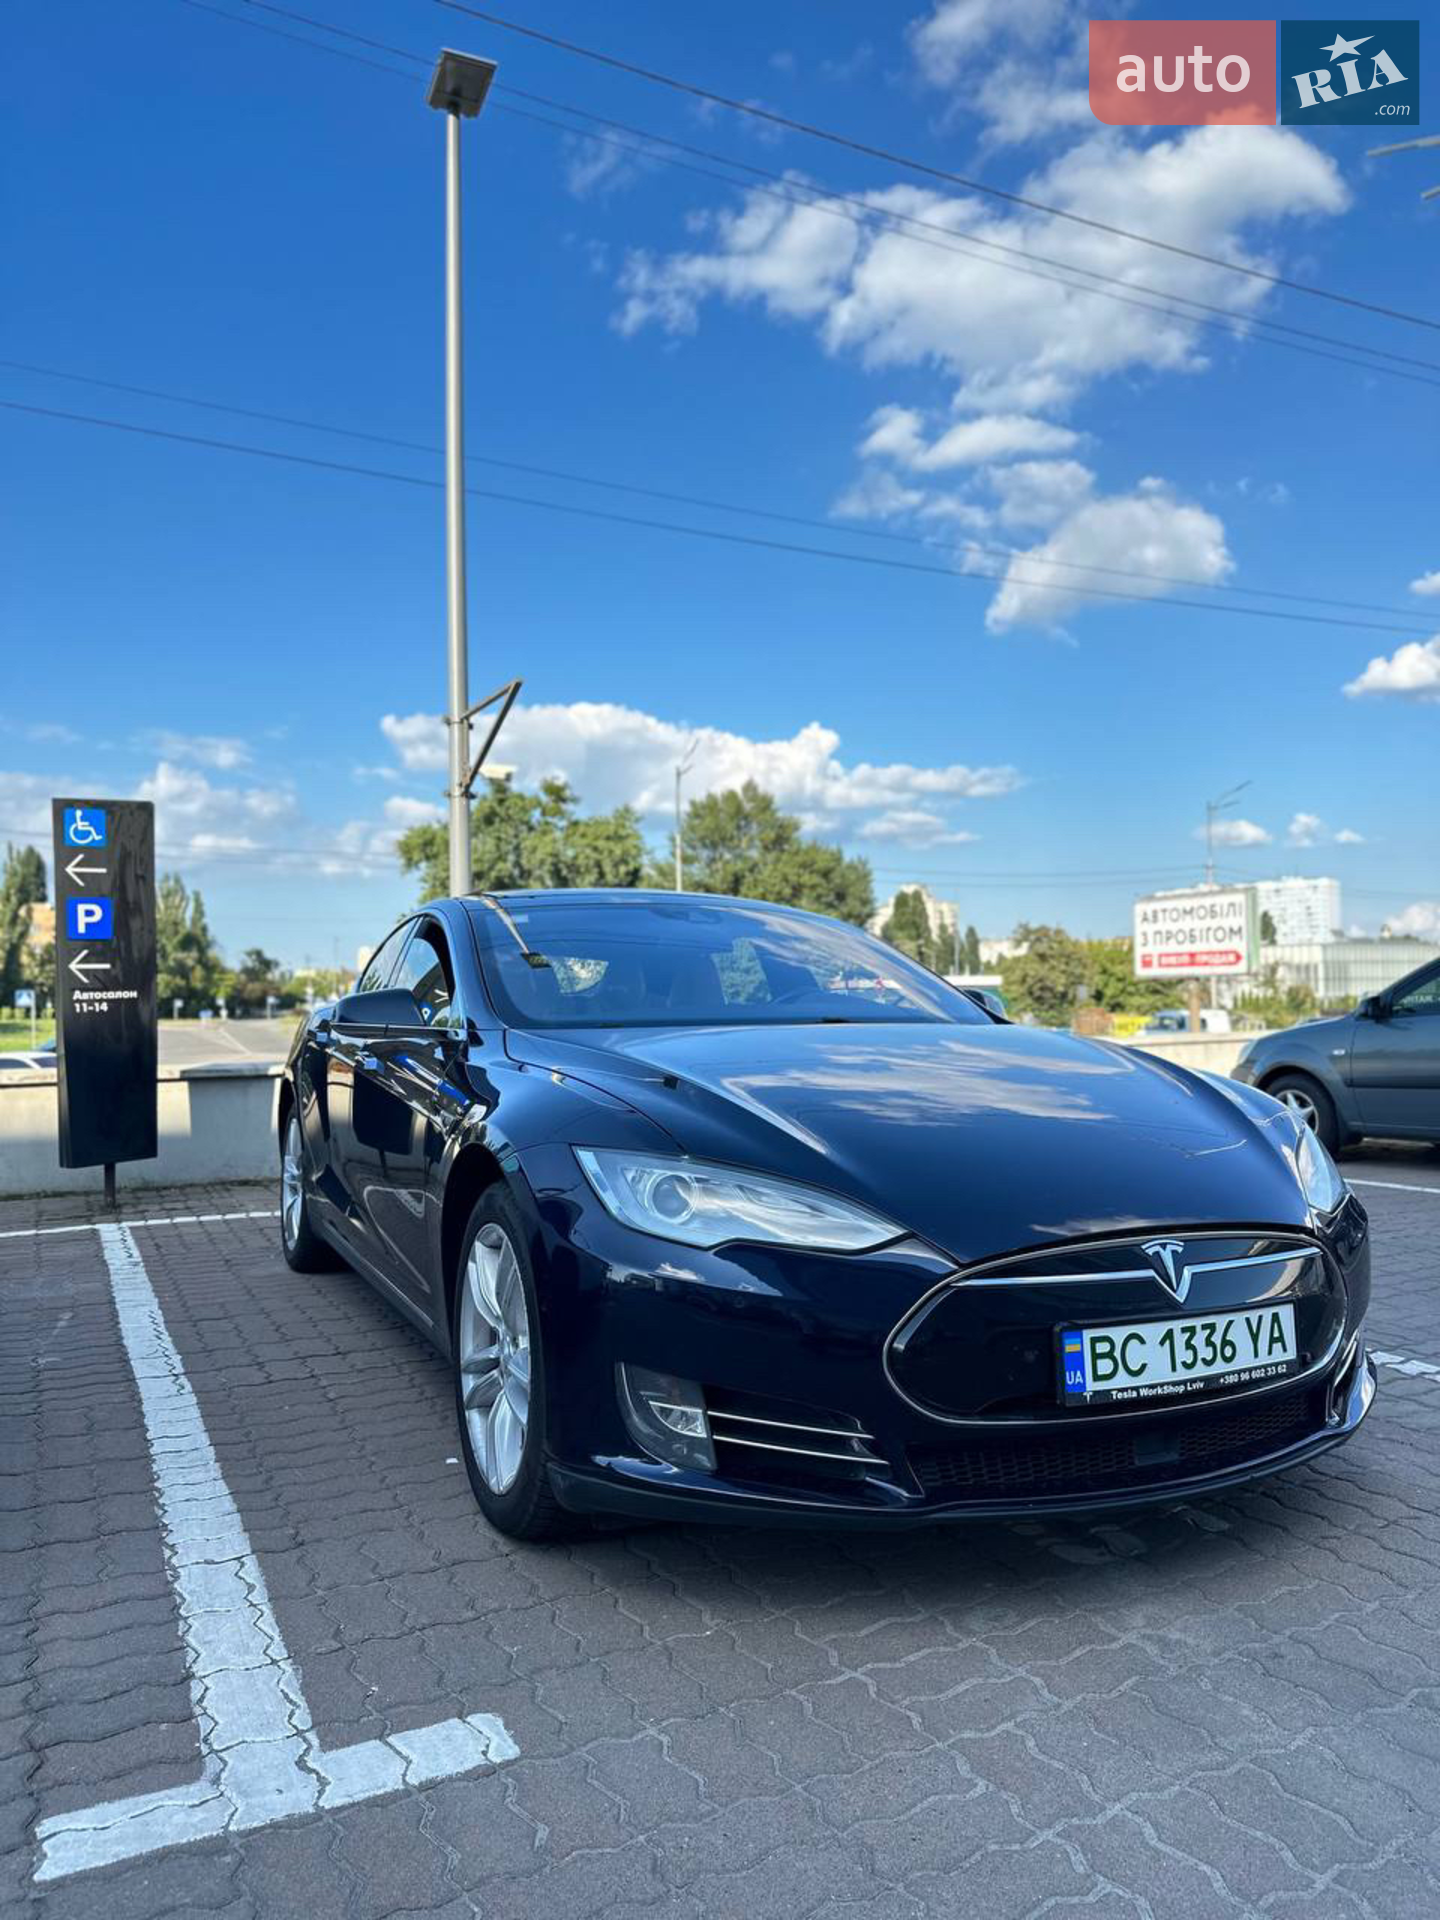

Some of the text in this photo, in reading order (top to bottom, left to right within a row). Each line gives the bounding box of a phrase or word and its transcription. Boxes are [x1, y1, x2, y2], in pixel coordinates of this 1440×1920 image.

[77, 903, 103, 934] P
[1141, 902, 1243, 924] АВТОМОБІЛІ
[1153, 925, 1243, 946] ПРОБІГОМ
[72, 989, 138, 1000] Автосалон
[74, 1001, 108, 1013] 11-14
[1089, 1311, 1288, 1383] BC 1336 YA
[1066, 1370, 1084, 1385] UA
[1220, 1374, 1239, 1384] +380
[1266, 1365, 1276, 1376] 33
[1111, 1380, 1205, 1400] Tesla WorkShop Lviv
